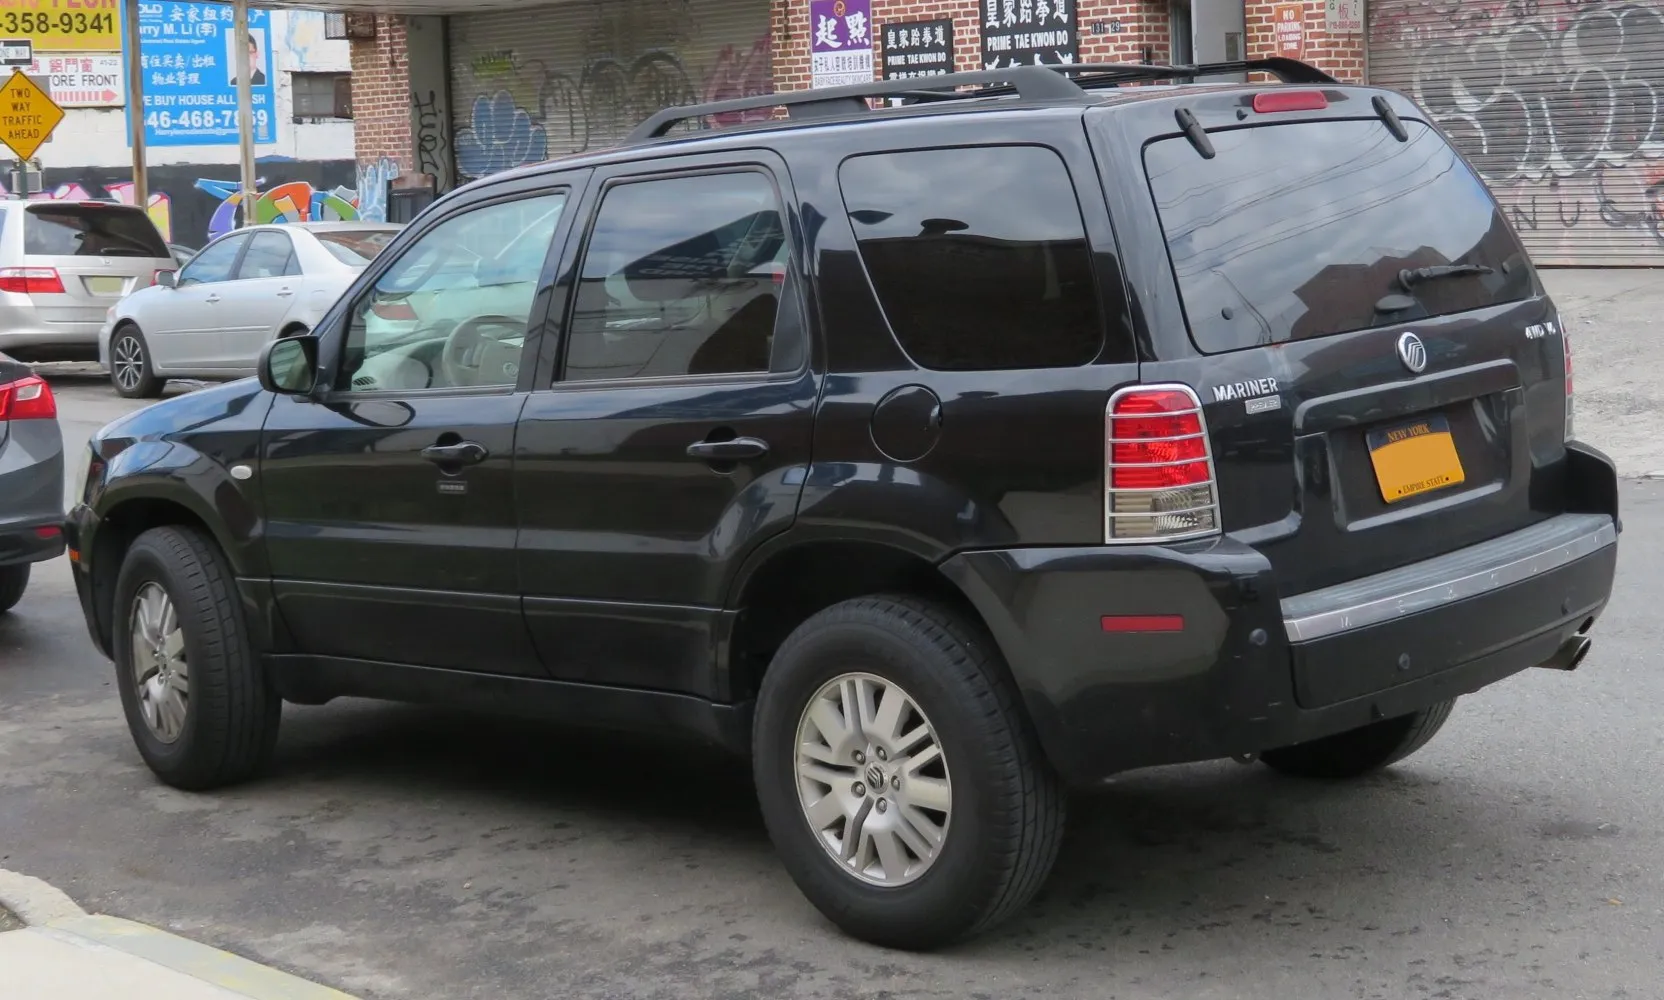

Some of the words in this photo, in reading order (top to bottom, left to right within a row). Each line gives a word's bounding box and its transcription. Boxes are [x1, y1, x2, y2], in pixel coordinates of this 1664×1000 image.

[1283, 10, 1295, 20] NO
[163, 23, 178, 35] M.
[181, 23, 193, 35] Li
[815, 11, 870, 48] 起點
[1092, 23, 1105, 33] 131
[1111, 22, 1120, 32] 29
[1277, 22, 1301, 33] PARKING
[987, 35, 1012, 52] PRIME
[1014, 33, 1030, 50] TAE
[1031, 31, 1055, 49] KWON
[1056, 30, 1069, 46] DO
[1278, 33, 1302, 42] LOADING
[1283, 41, 1299, 51] ZONE
[887, 55, 906, 67] PRIME
[908, 54, 919, 65] TAE
[919, 53, 937, 64] KWON
[937, 52, 947, 63] DO
[81, 74, 119, 87] FRONT
[10, 88, 31, 99] TWO
[154, 95, 176, 106] BUY
[179, 95, 214, 106] HOUSE
[216, 94, 237, 105] ALL
[11, 101, 32, 112] WAY
[2, 115, 43, 126] TRAFFIC
[8, 128, 40, 140] AHEAD
[1212, 377, 1279, 402] MARINER
[1387, 428, 1408, 442] NEW
[1408, 423, 1431, 437] YORK
[1402, 481, 1427, 495] EMPIRE
[1426, 476, 1445, 489] STATE
